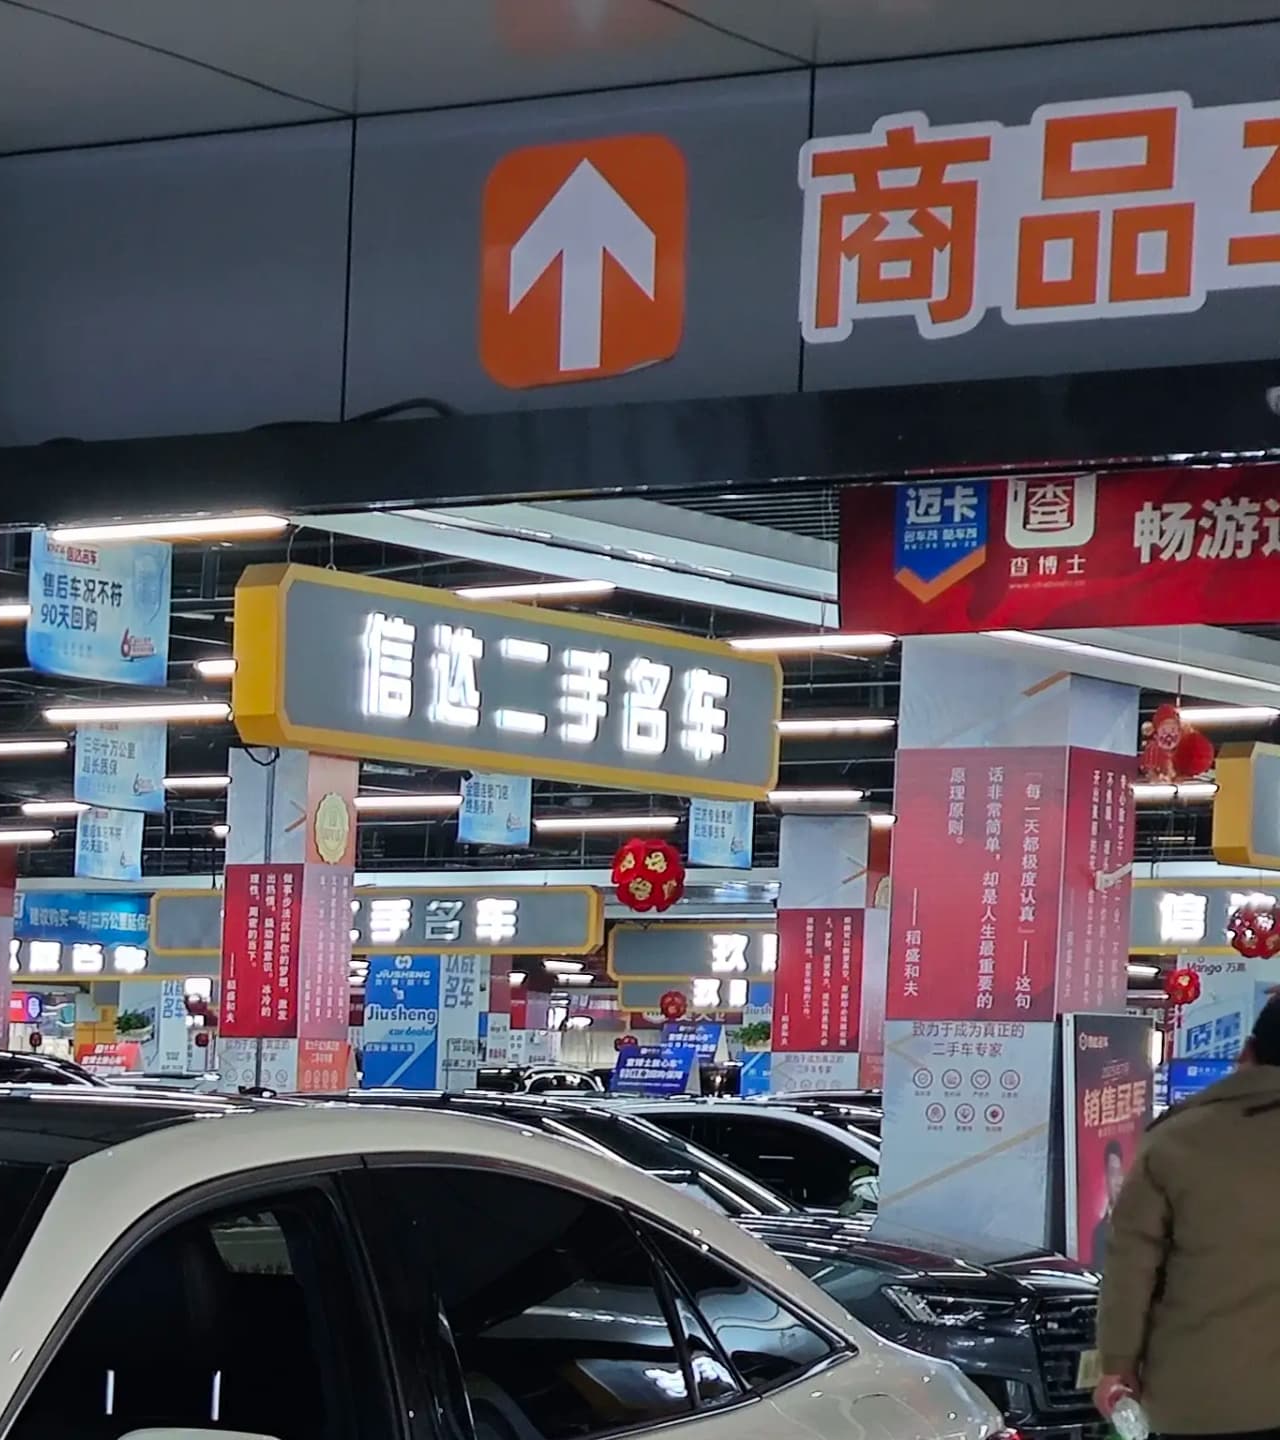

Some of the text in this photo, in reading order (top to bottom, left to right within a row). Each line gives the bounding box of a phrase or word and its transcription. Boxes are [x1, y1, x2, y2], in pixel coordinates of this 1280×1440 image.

[905, 485, 978, 525] 迈卡
[1134, 497, 1280, 563] 畅游
[1011, 554, 1086, 577] 查博士
[43, 571, 123, 609] 售后车况不符
[40, 603, 99, 633] 90天回购
[362, 611, 730, 761] 信达二手名车
[83, 737, 137, 760] 三年十万公里
[947, 767, 967, 844] 原理原则。
[976, 767, 1005, 1009] 话非常简单，却是人生最重要的
[367, 1002, 437, 1025] Jiusheng
[912, 1021, 1025, 1040] 致力于成为真正的
[932, 1041, 1005, 1058] 二手车专家
[1083, 1079, 1148, 1128] 销售冠军
